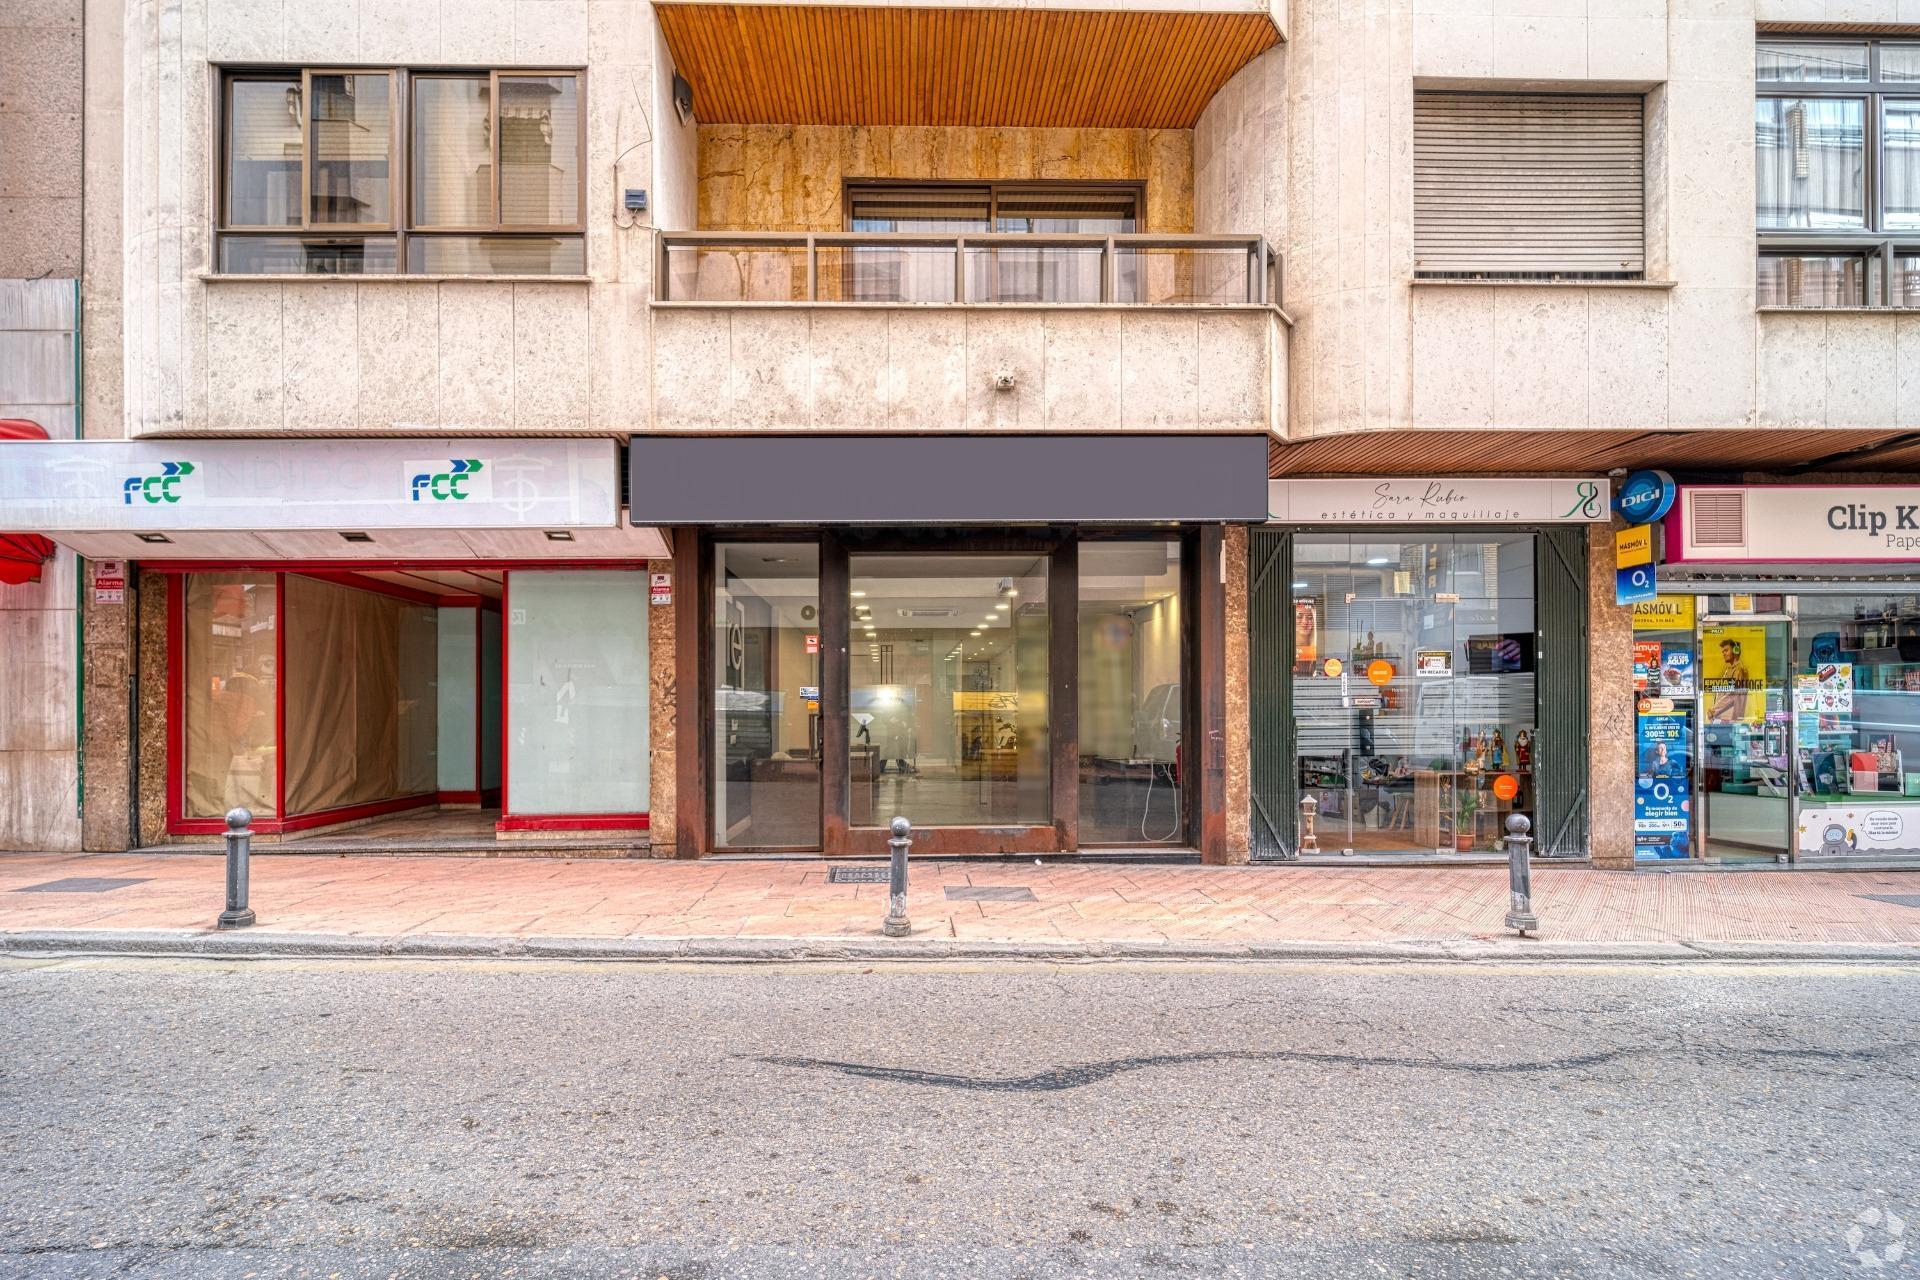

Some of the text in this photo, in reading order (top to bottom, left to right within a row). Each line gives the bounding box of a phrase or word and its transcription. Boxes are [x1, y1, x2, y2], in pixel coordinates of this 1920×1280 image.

[124, 477, 182, 504] FCC
[412, 473, 469, 501] FCC
[1372, 481, 1467, 509] Sara Rubio
[1621, 488, 1660, 508] DIGI
[1321, 510, 1395, 519] estética
[1425, 510, 1520, 521] maquillaje
[1827, 504, 1887, 536] Clip
[1634, 601, 1682, 615] ÁSMÓVIL
